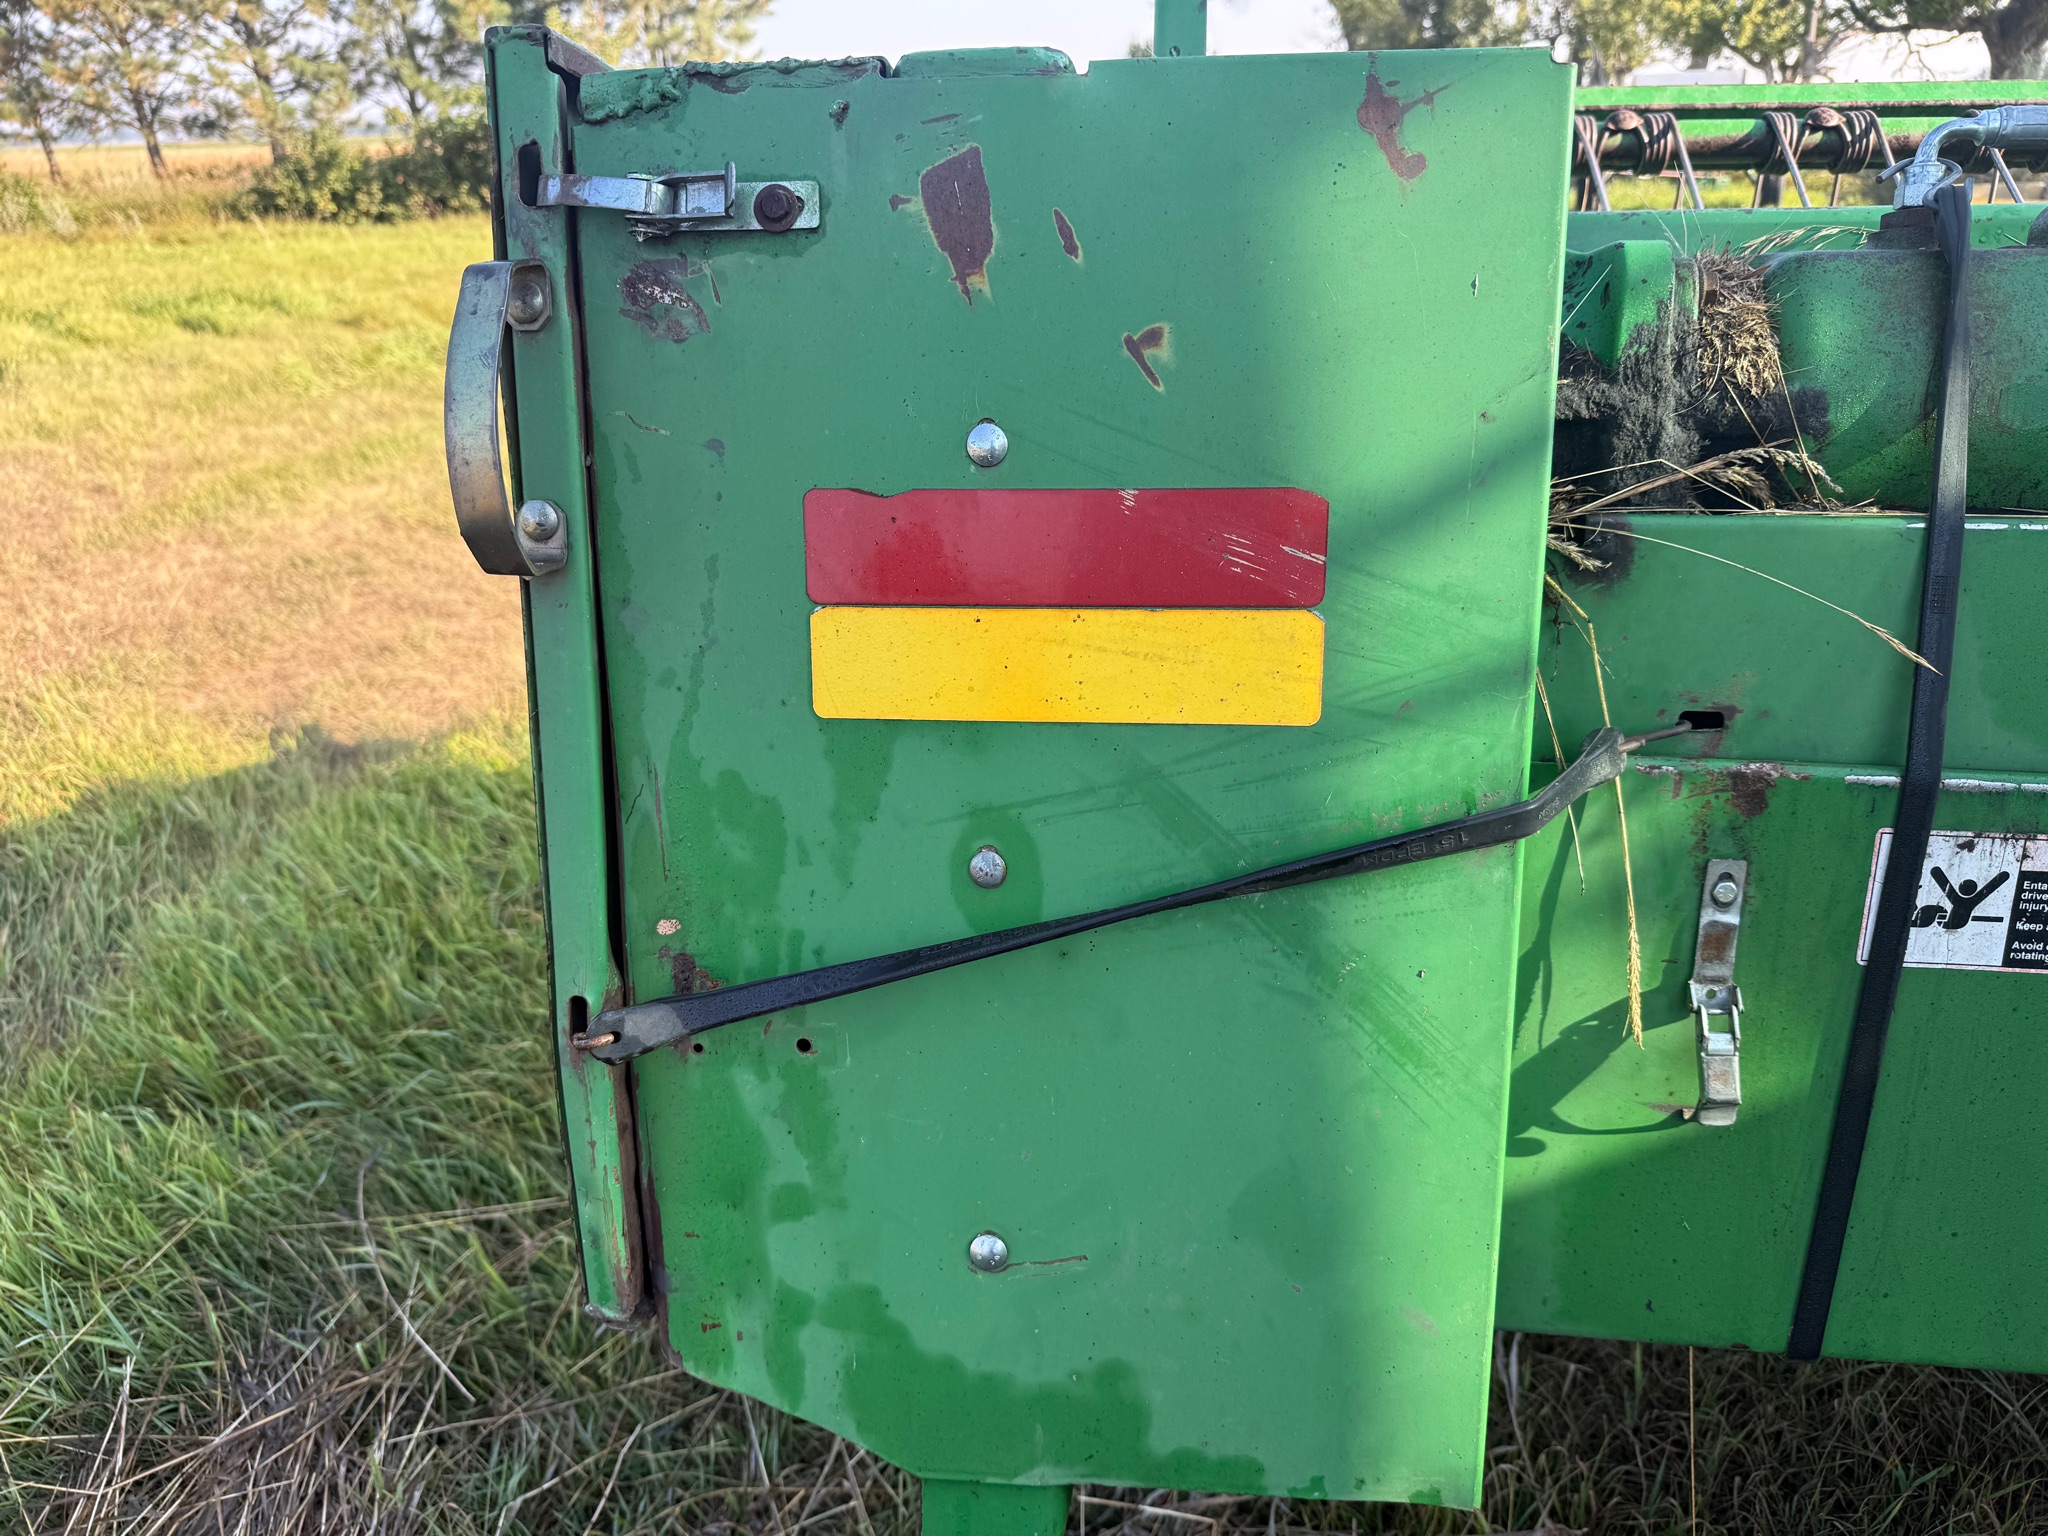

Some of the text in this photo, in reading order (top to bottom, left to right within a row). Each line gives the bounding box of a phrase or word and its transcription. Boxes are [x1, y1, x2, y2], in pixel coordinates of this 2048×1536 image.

[2021, 891, 2048, 900] drive
[2016, 920, 2043, 932] Keep
[2011, 941, 2044, 951] Avoid
